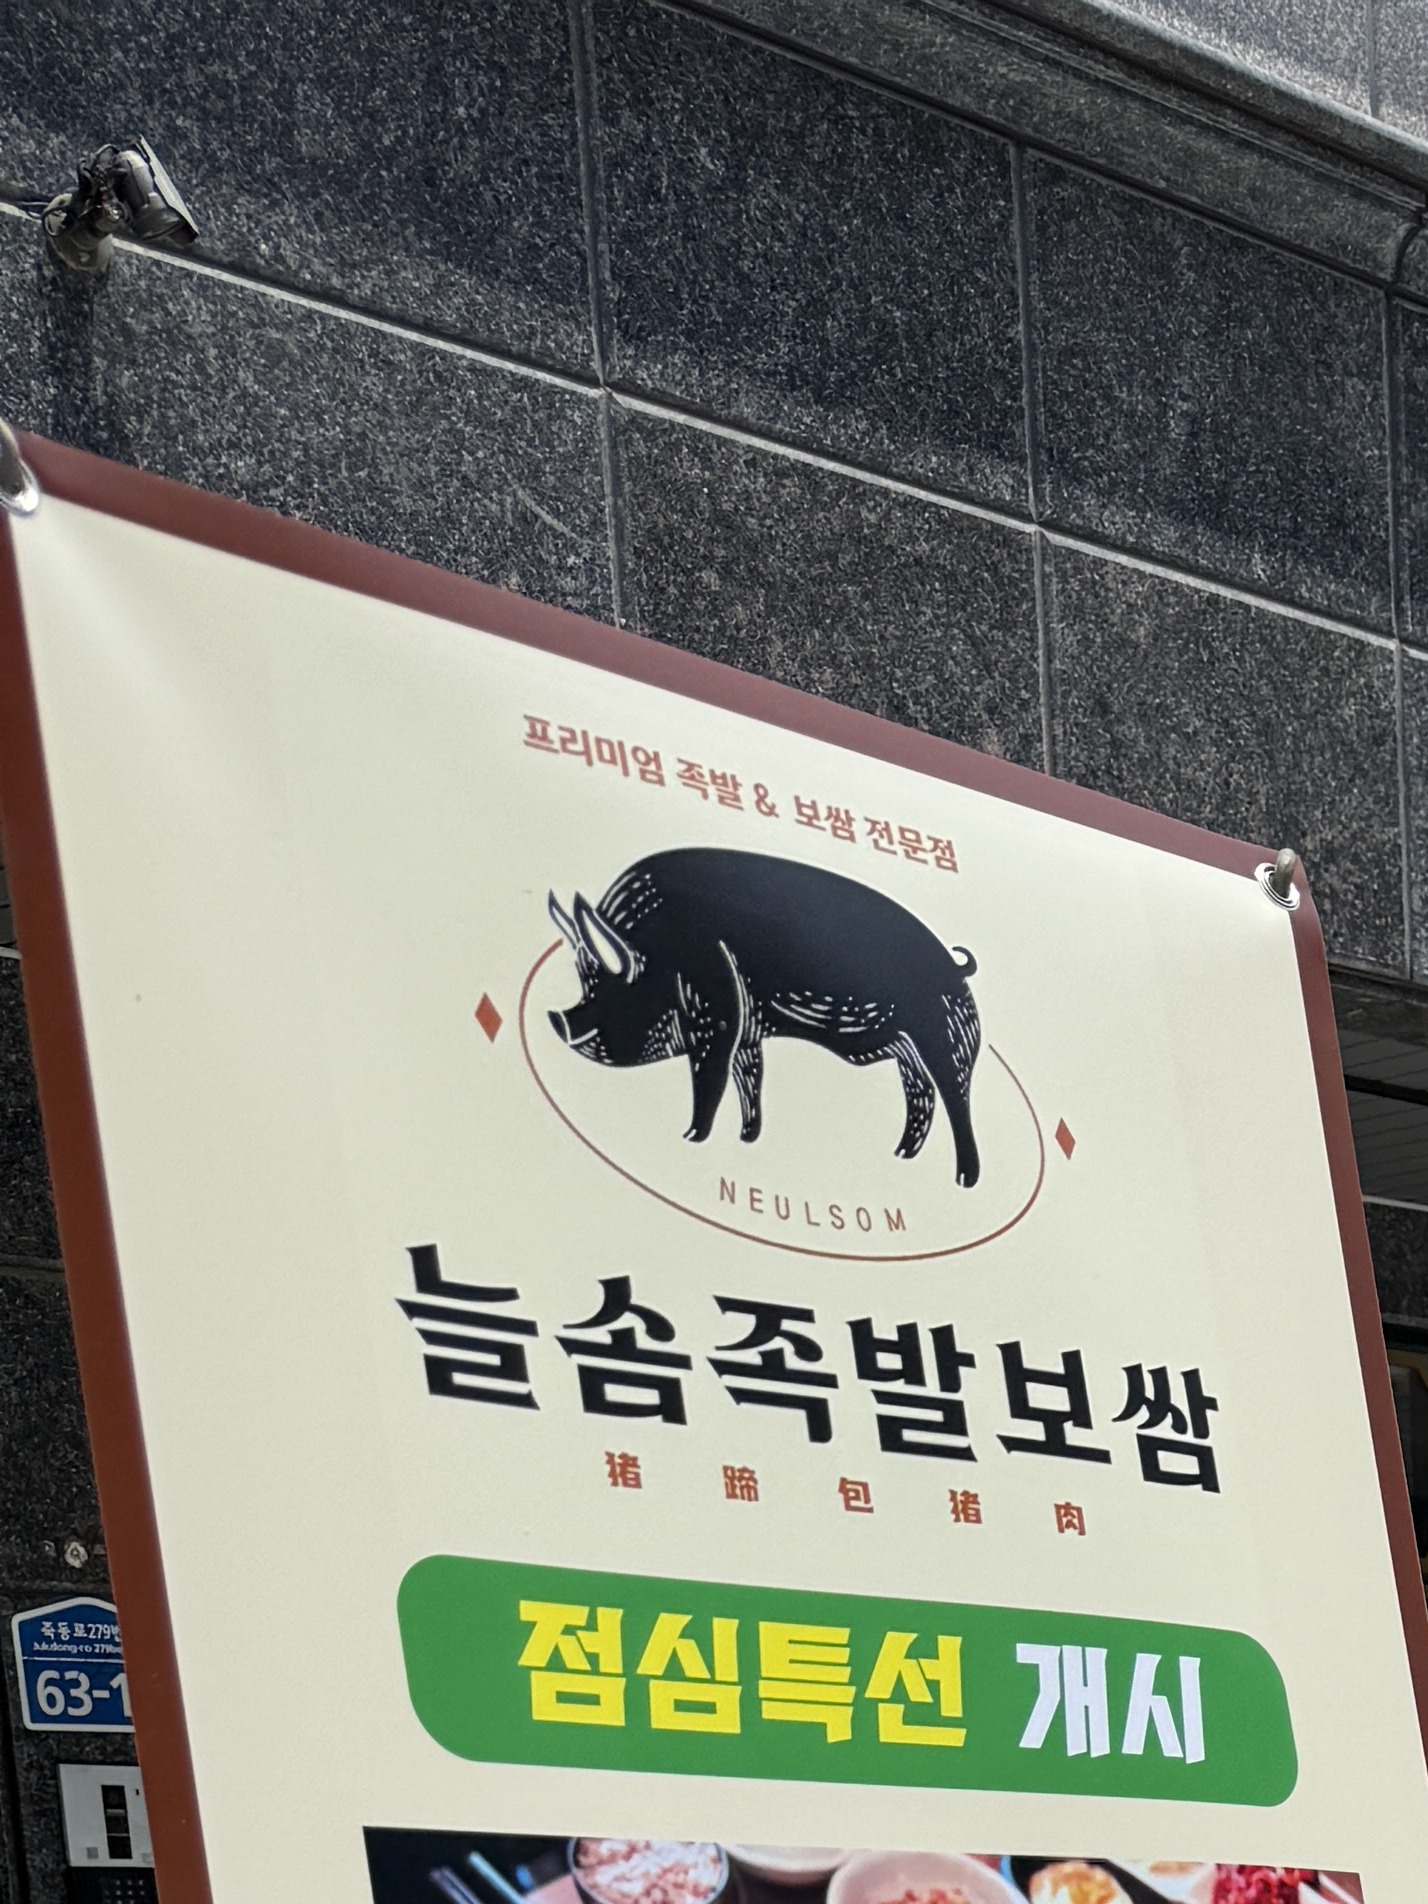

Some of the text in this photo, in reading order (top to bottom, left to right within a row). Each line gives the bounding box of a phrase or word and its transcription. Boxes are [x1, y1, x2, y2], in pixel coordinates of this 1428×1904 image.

[523, 715, 959, 873] 프리미엄 족발 & 보쌈 전문점
[719, 1176, 907, 1232] NEULSOM
[395, 1243, 1221, 1494] 늘솜족발보쌈
[517, 1600, 1205, 1764] 점심특선 개시
